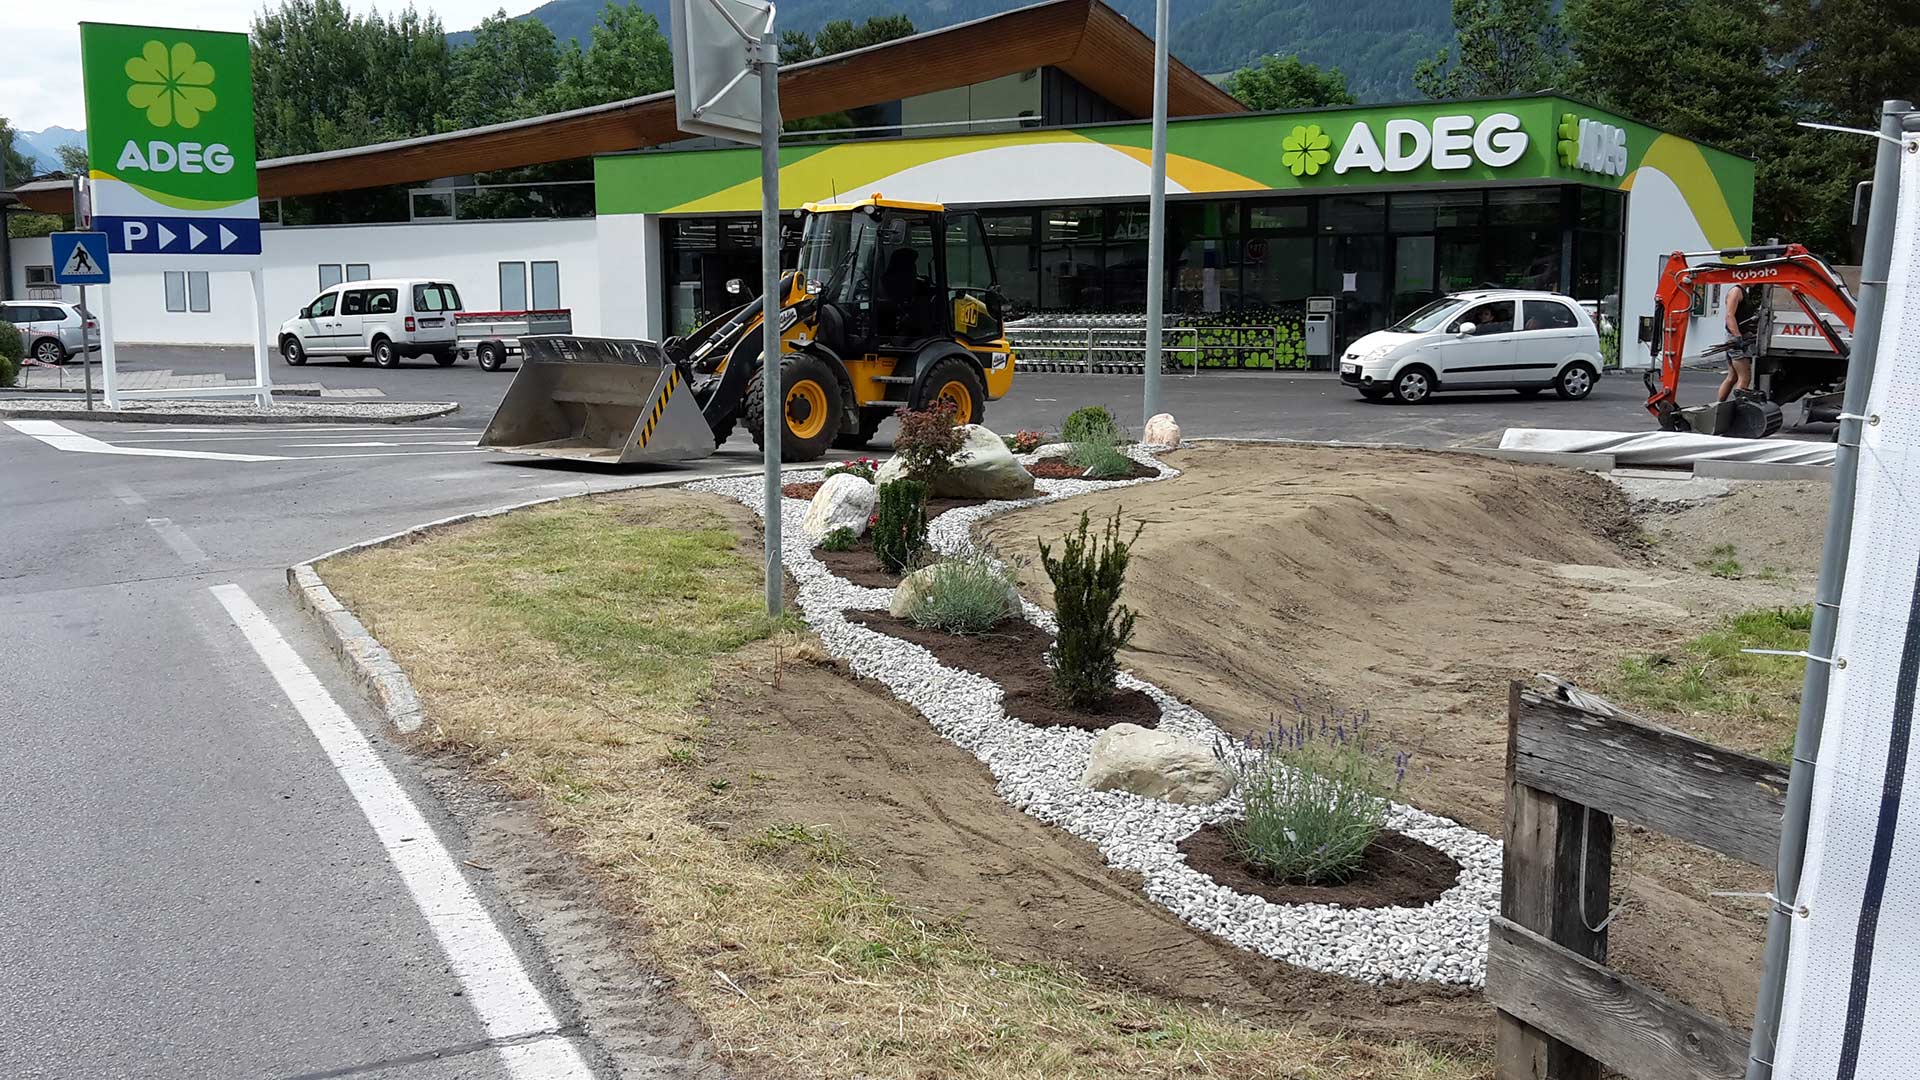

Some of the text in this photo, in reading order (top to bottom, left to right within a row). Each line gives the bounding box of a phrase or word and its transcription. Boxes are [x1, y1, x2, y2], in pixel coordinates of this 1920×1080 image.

[116, 140, 235, 174] ADEG
[1333, 113, 1529, 175] ADEG
[1575, 118, 1628, 176] ADEG
[123, 221, 149, 251] P
[1113, 223, 1149, 240] ADE
[1732, 267, 1778, 280] Kubota
[1782, 324, 1816, 336] AKTI
